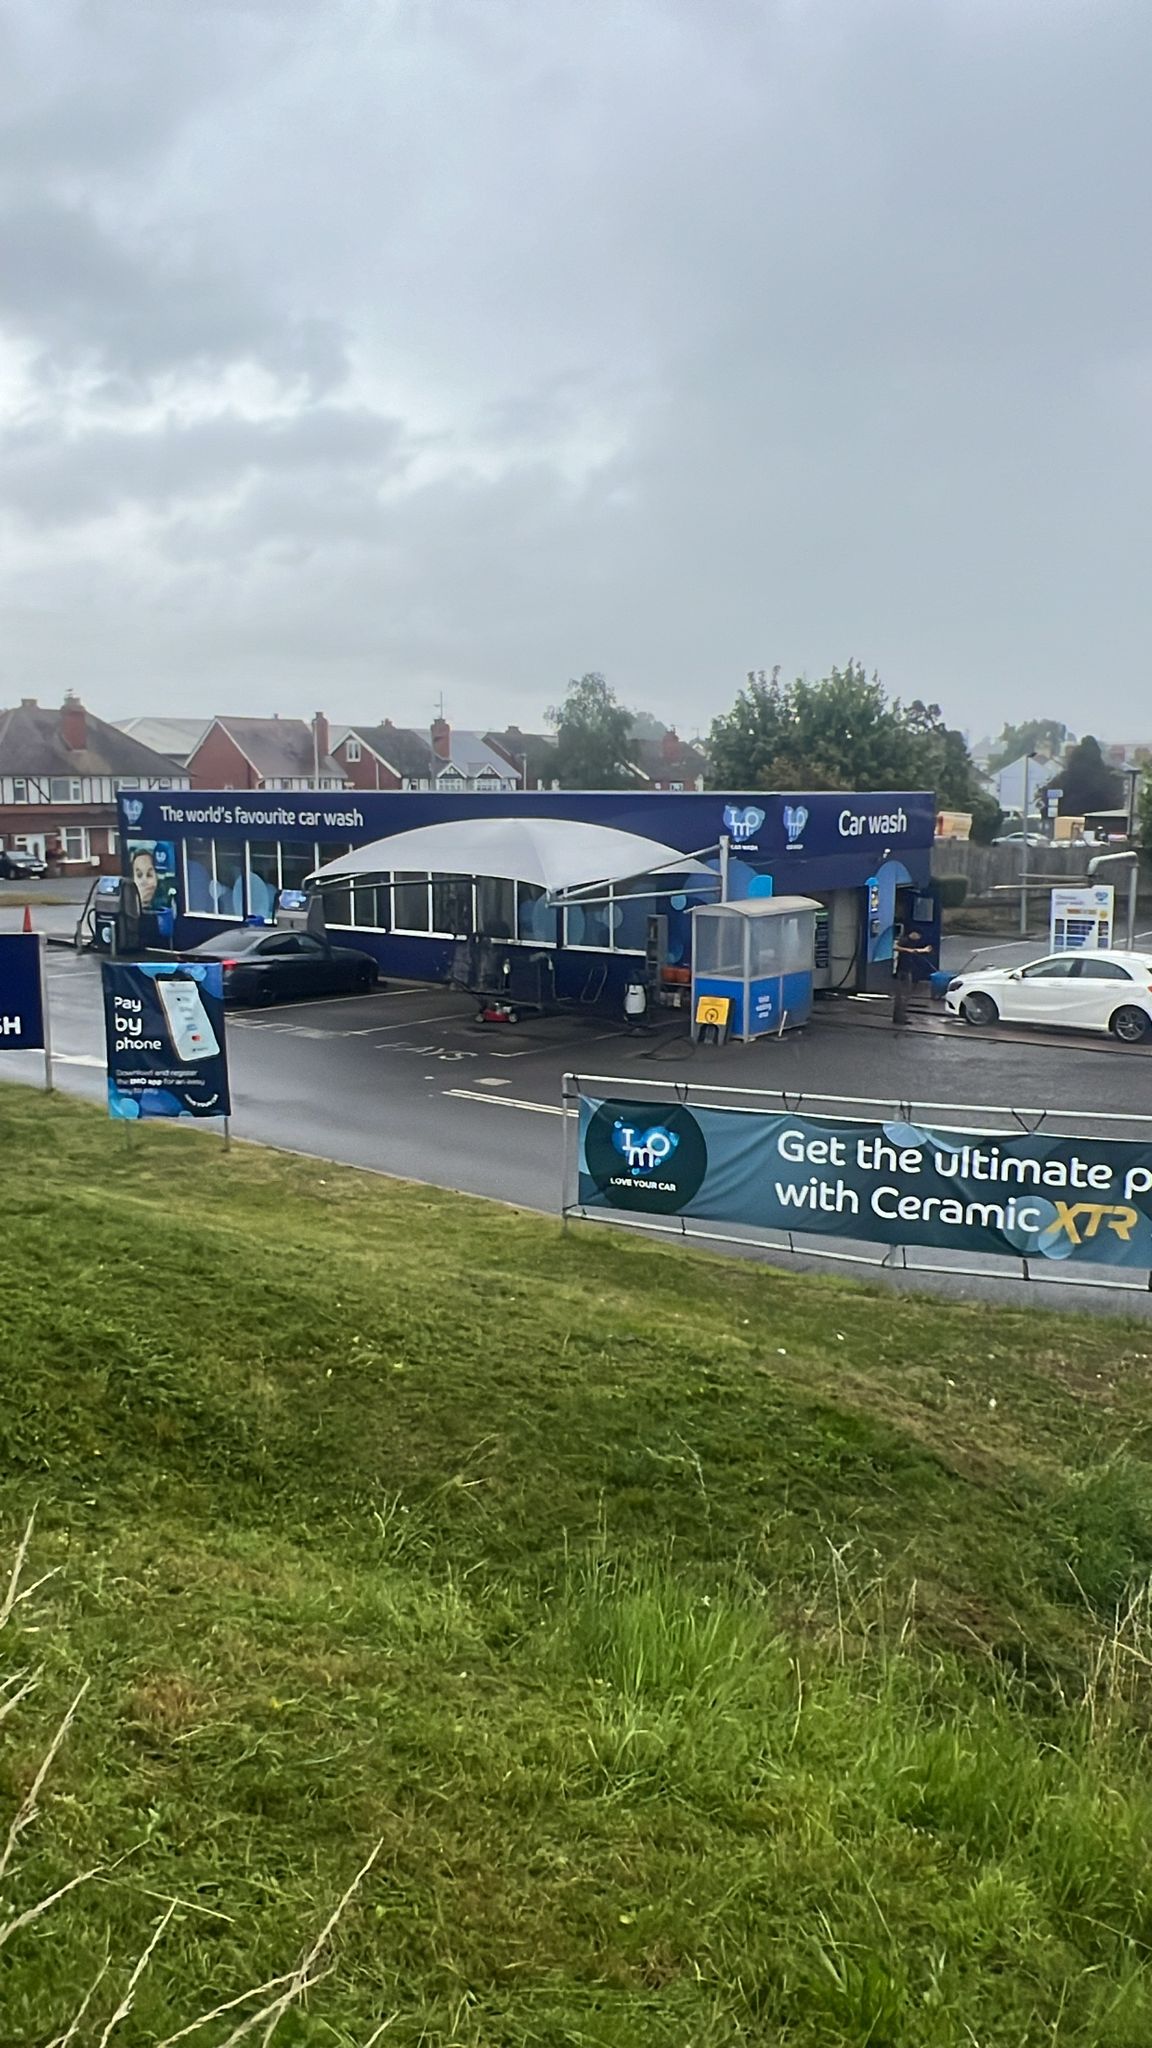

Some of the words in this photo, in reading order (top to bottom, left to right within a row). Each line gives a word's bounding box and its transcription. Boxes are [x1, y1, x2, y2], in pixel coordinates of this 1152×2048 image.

[160, 805, 184, 822] The
[185, 805, 233, 823] world's
[235, 806, 296, 826] favourite
[298, 812, 322, 826] car
[324, 808, 364, 827] wash
[838, 809, 866, 837] Car
[868, 807, 907, 835] wash
[114, 996, 142, 1013] Pay
[0, 1016, 21, 1035] H
[114, 1012, 142, 1036] by
[115, 1036, 162, 1053] phone
[776, 1129, 847, 1166] Get
[856, 1137, 923, 1175] the
[933, 1145, 1114, 1190] ultimate
[610, 1176, 633, 1188] LOVE
[632, 1178, 658, 1191] YOUR
[657, 1180, 678, 1193] CAR
[775, 1176, 860, 1214] with
[870, 1186, 1041, 1232] Ceramic
[1043, 1200, 1139, 1245] XTR
